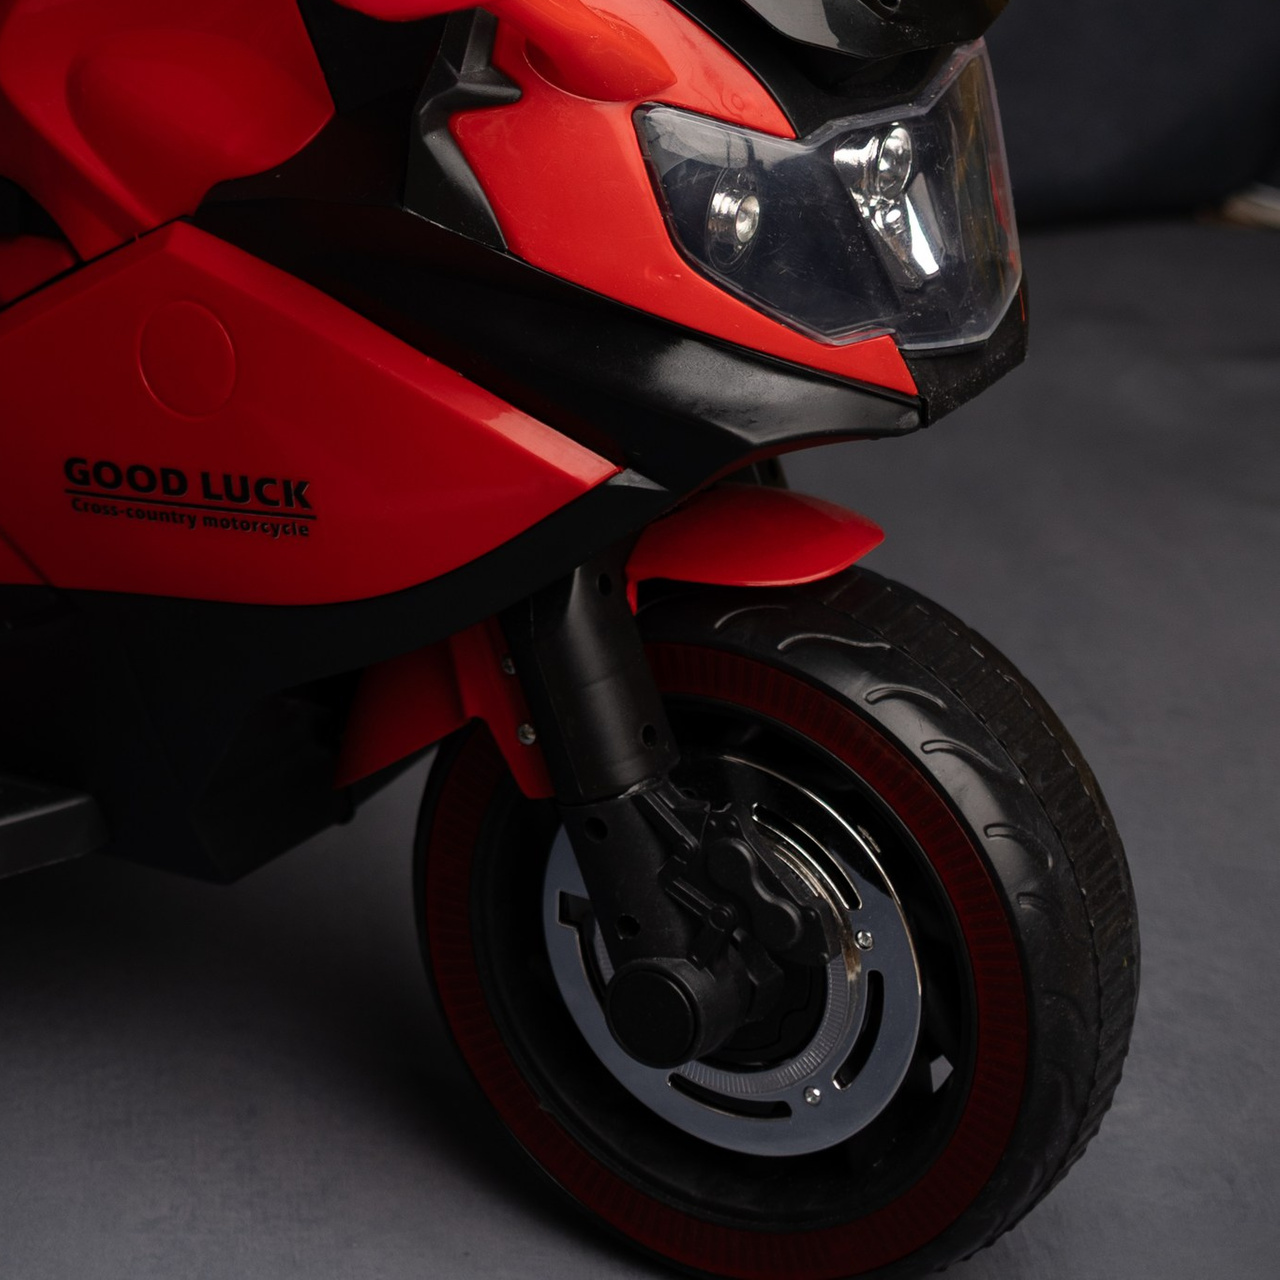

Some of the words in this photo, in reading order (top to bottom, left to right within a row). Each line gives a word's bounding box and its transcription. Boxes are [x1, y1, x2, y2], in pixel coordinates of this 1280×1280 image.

[63, 456, 189, 497] GOOD
[200, 471, 314, 510] LUCK
[71, 496, 197, 530] Cross-country
[202, 514, 311, 538] motorcycle
